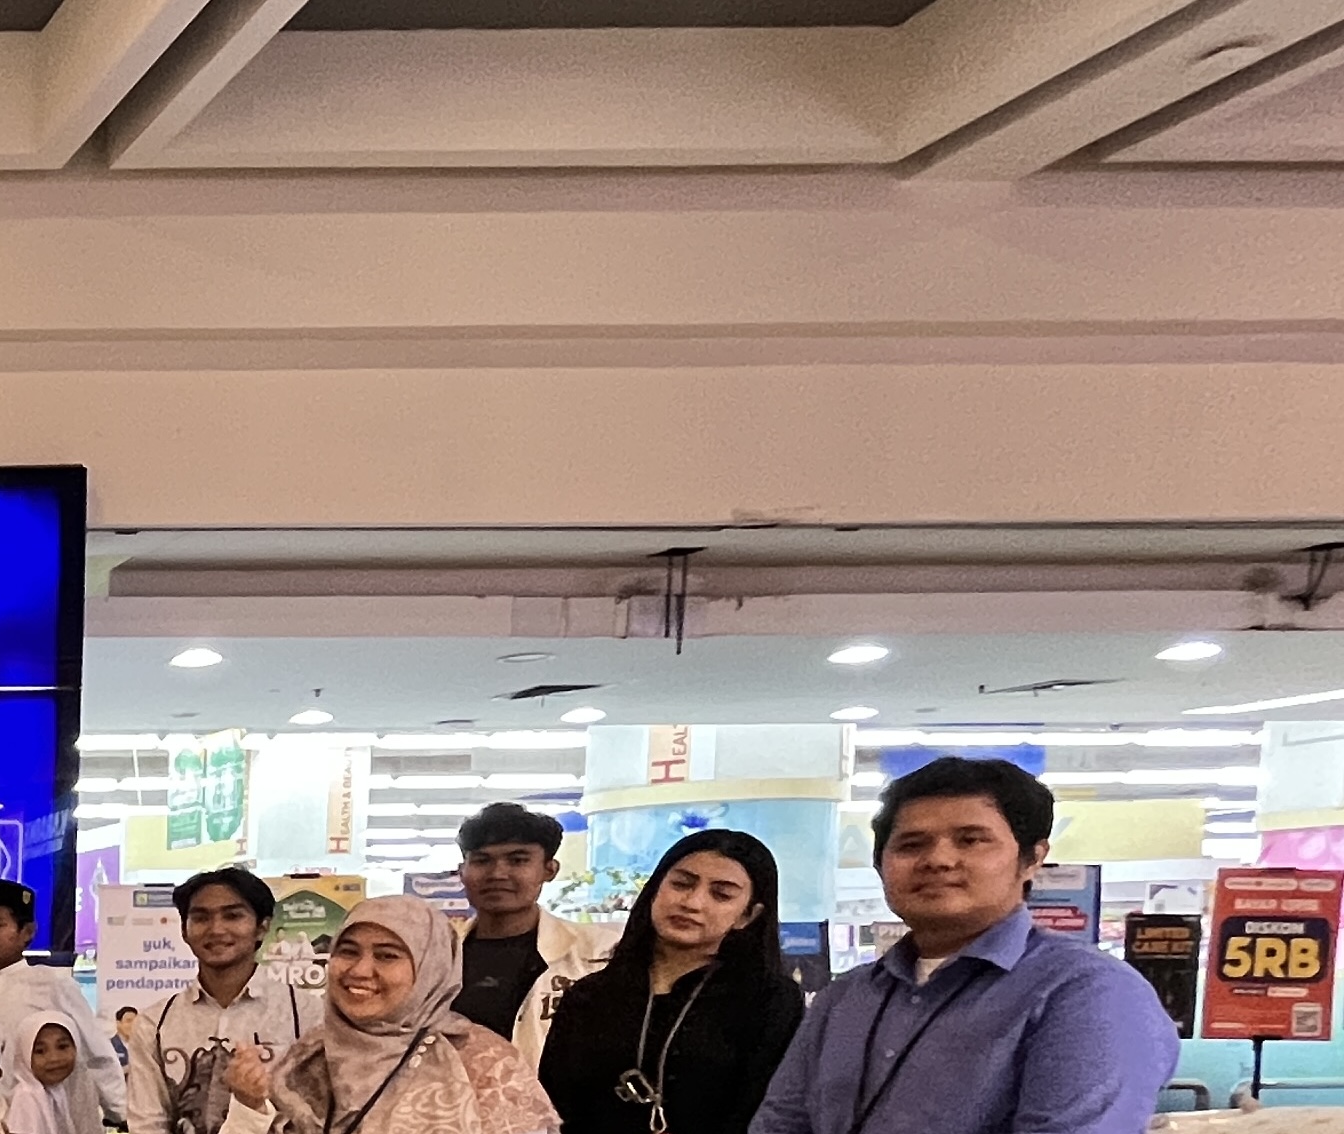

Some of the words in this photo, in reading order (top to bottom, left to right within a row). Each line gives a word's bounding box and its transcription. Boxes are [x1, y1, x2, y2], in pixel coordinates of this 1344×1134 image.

[651, 724, 688, 785] HEAL
[143, 938, 176, 952] yuk,
[1222, 936, 1322, 979] 5RB
